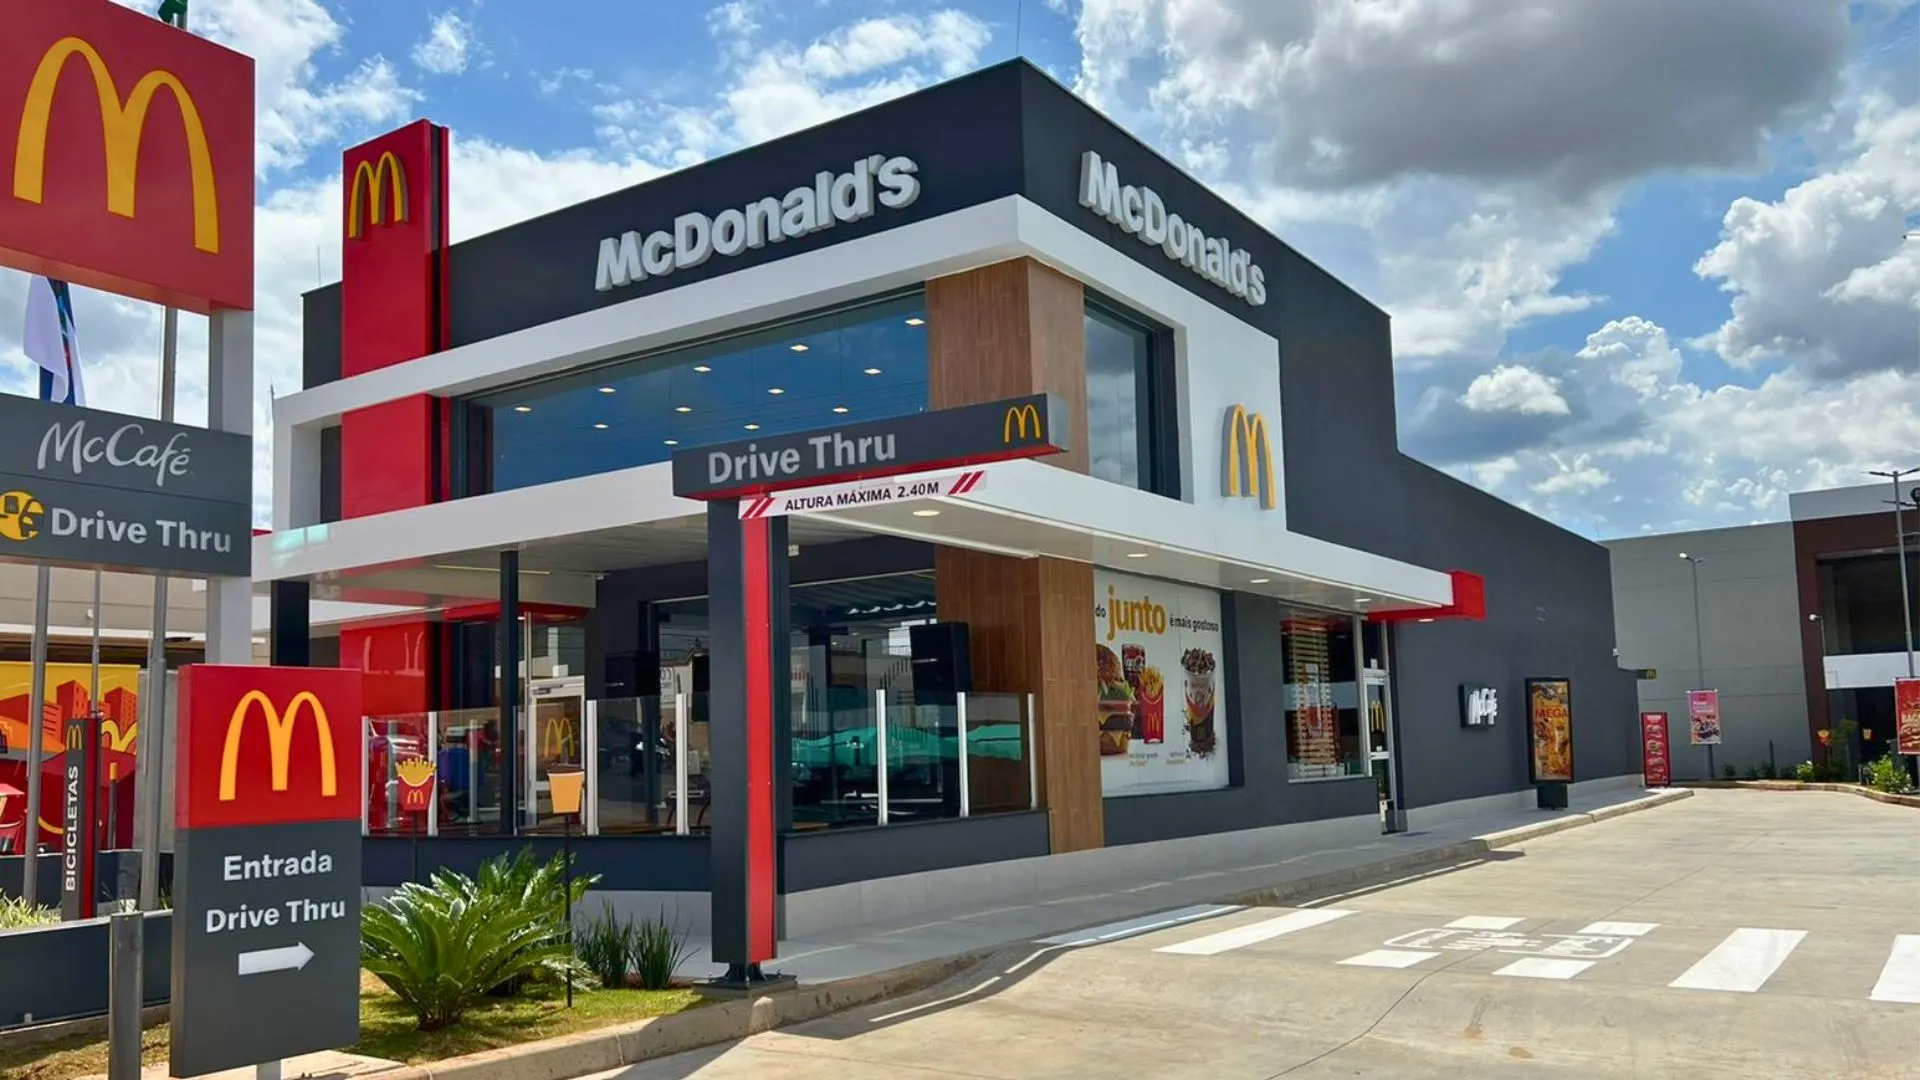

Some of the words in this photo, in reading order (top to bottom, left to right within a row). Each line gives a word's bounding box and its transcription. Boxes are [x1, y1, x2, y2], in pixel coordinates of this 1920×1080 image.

[595, 154, 921, 291] McDonald's
[1079, 150, 1267, 306] McDonald's
[37, 420, 192, 487] McCafé
[708, 444, 801, 485] Drive
[808, 432, 897, 469] Thru
[784, 495, 833, 511] ALTURA
[836, 488, 892, 507] MÁXIMA
[898, 481, 939, 499] 2.40M
[51, 507, 147, 544] Drive
[155, 519, 231, 552] Thru
[1107, 584, 1167, 642] junto
[1174, 615, 1191, 629] mais
[1192, 618, 1219, 633] gostoso
[65, 766, 79, 892] BICICLETAS
[223, 850, 333, 882] Entrada
[206, 904, 280, 933] Drive
[286, 899, 346, 924] Thru
